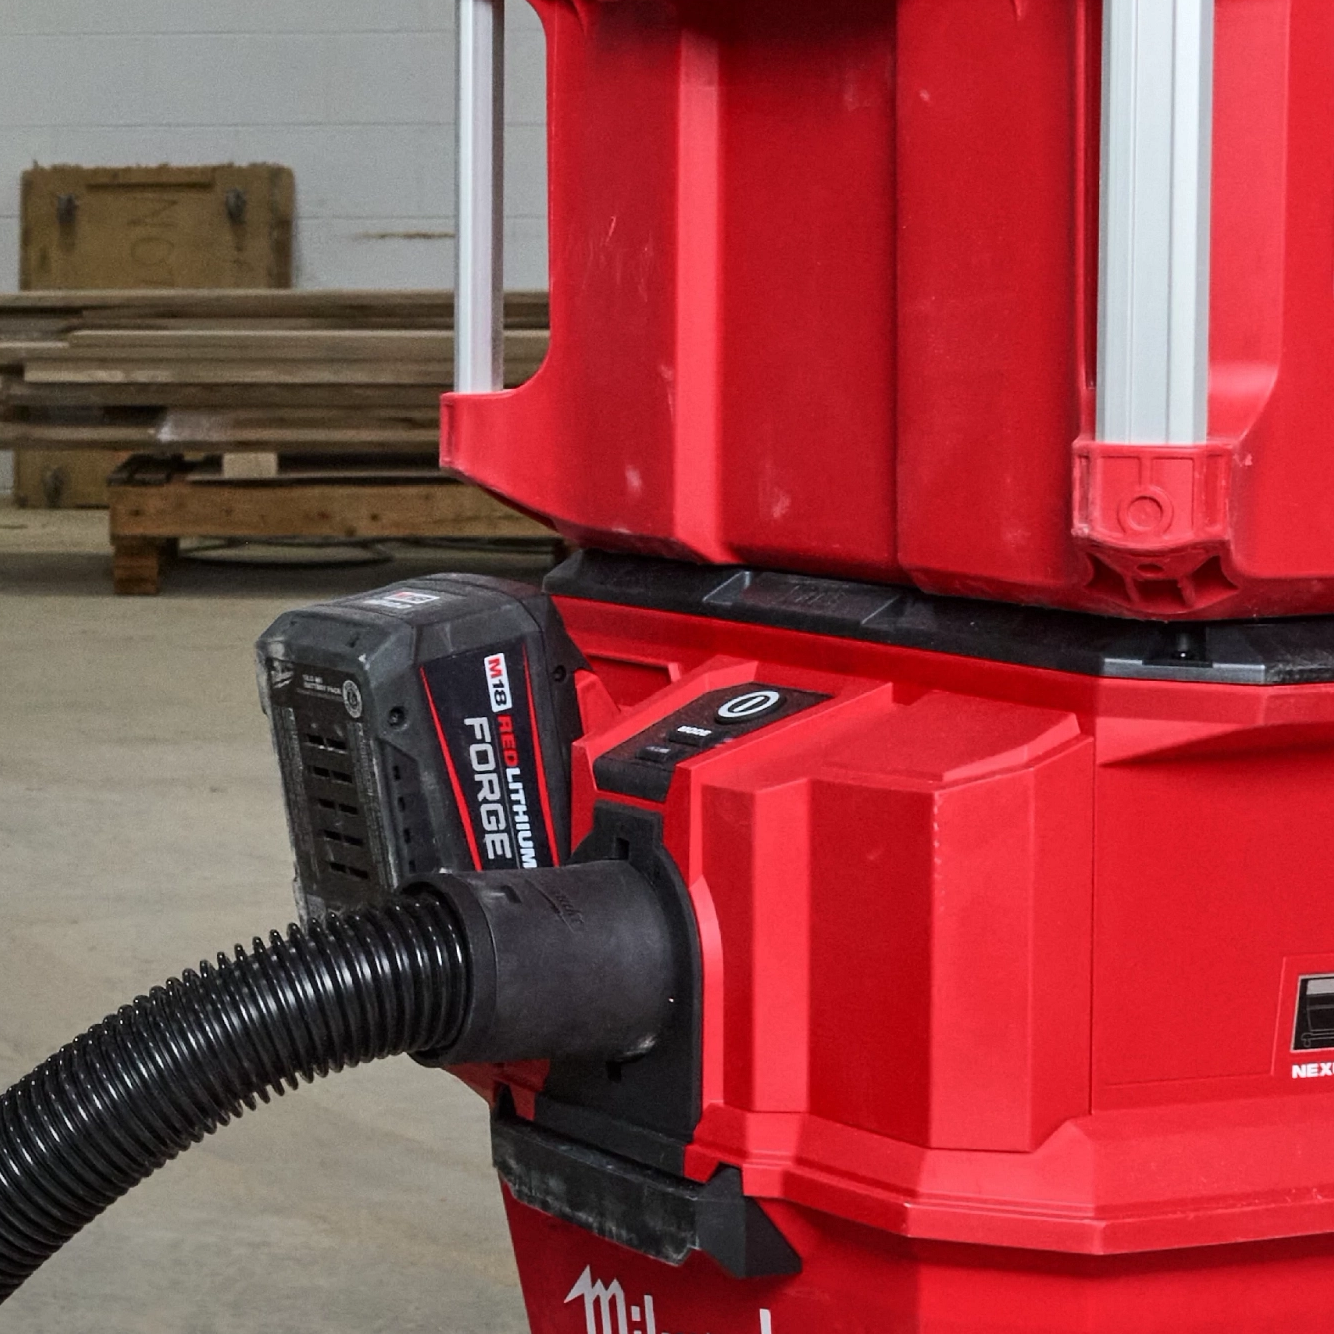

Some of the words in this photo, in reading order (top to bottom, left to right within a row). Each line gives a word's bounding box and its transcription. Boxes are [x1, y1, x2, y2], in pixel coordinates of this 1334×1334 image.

[487, 656, 508, 708] M18
[464, 717, 512, 859] FORGE
[497, 714, 538, 869] REDLITHIUM
